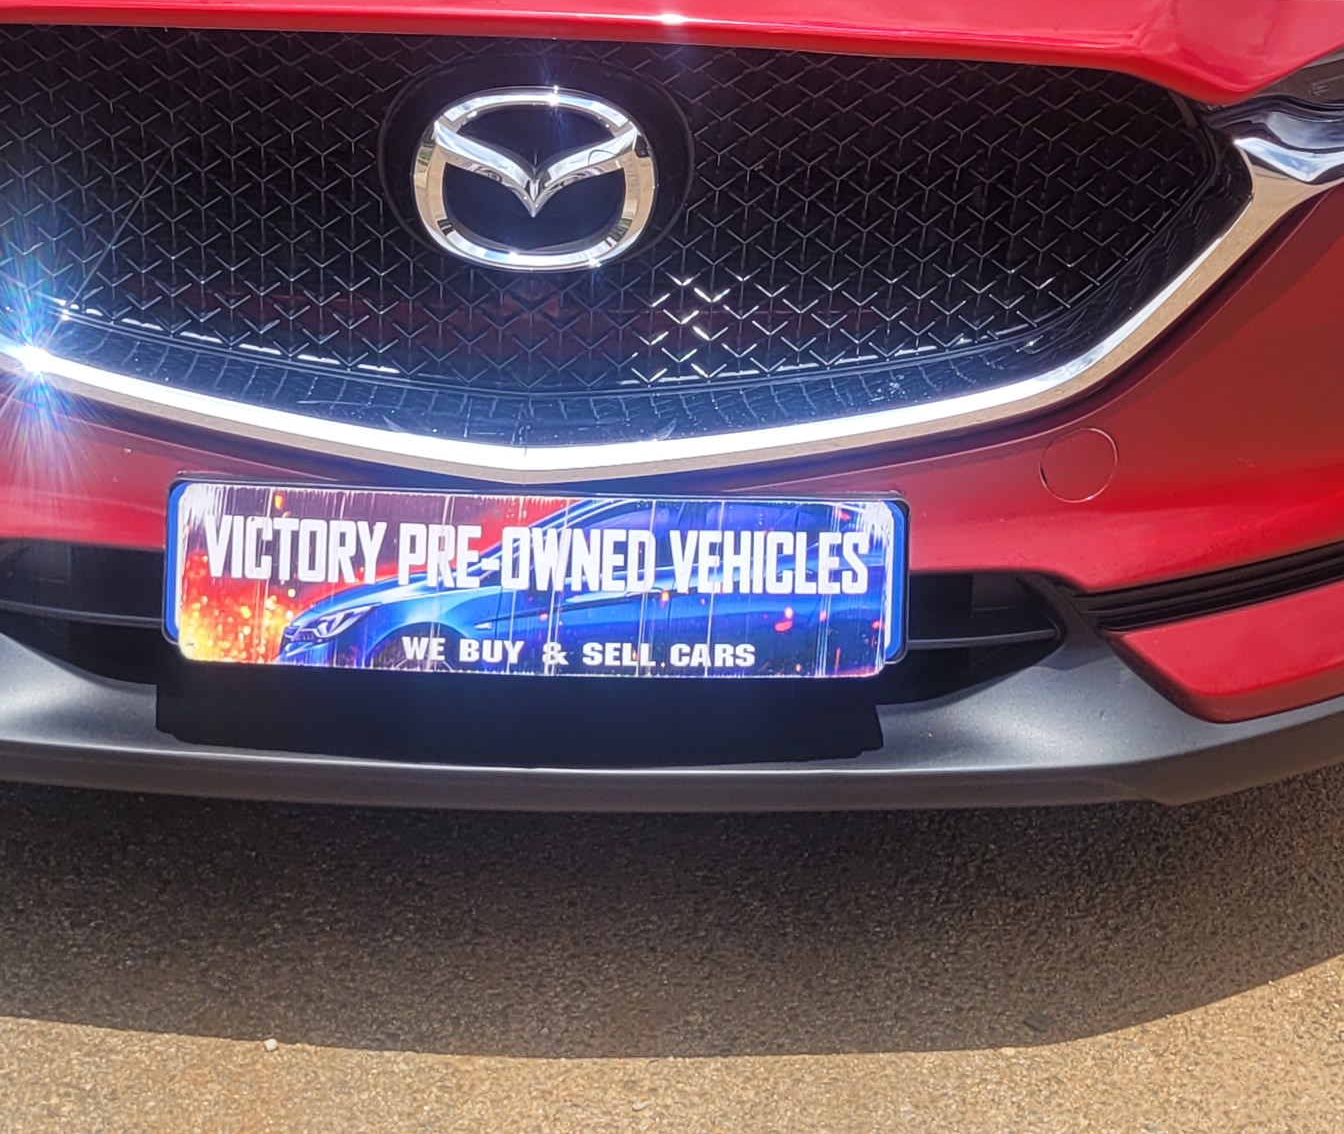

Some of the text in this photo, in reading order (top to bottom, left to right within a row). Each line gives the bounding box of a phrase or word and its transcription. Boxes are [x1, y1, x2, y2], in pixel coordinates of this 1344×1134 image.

[205, 514, 387, 584] VICTORY
[669, 530, 870, 595] VEHICLES
[402, 636, 756, 668] WE BUY & SELL CARS
